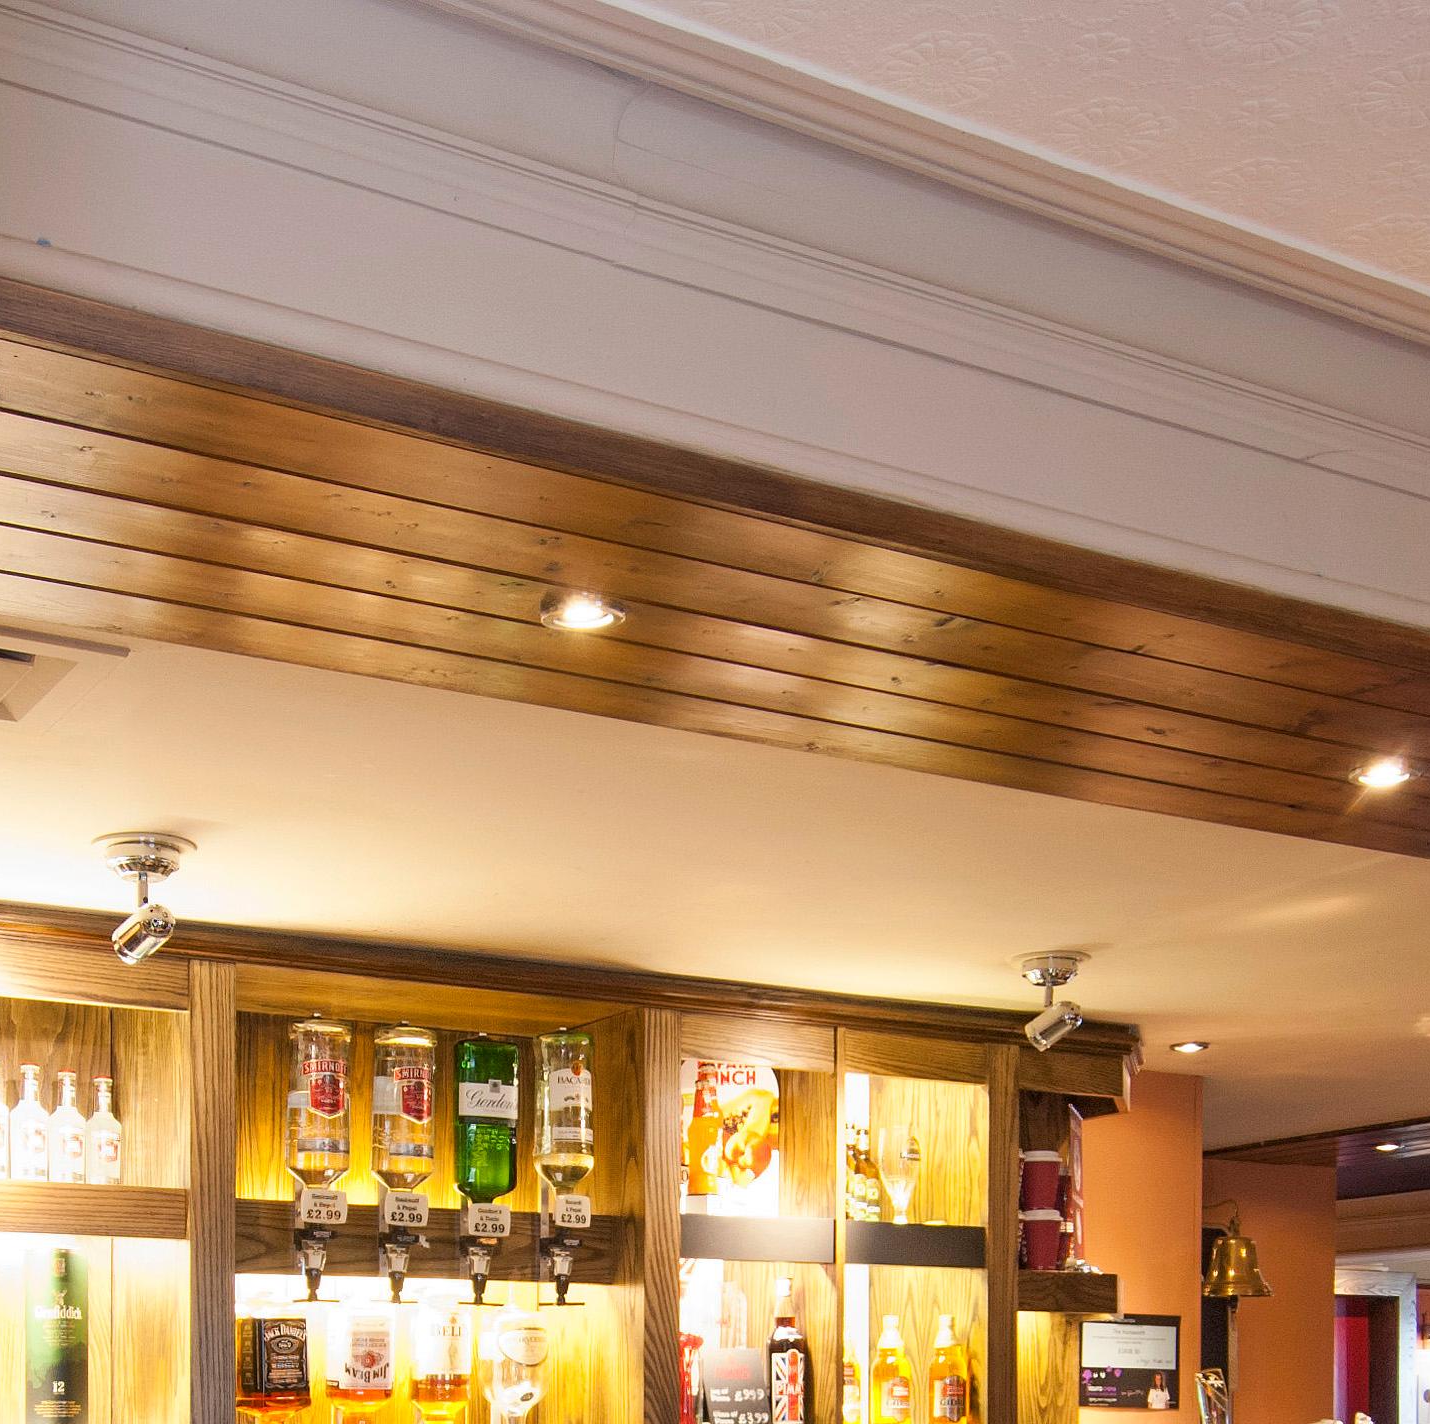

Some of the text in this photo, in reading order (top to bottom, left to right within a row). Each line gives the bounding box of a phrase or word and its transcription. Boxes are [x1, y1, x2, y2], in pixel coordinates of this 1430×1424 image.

[307, 1209, 341, 1220] £2.99
[391, 1211, 423, 1223] £2.99
[561, 1213, 587, 1224] £2.99
[474, 1222, 505, 1233] £2.99
[345, 1363, 389, 1383] JIM BEAM
[52, 1381, 65, 1393] 12
